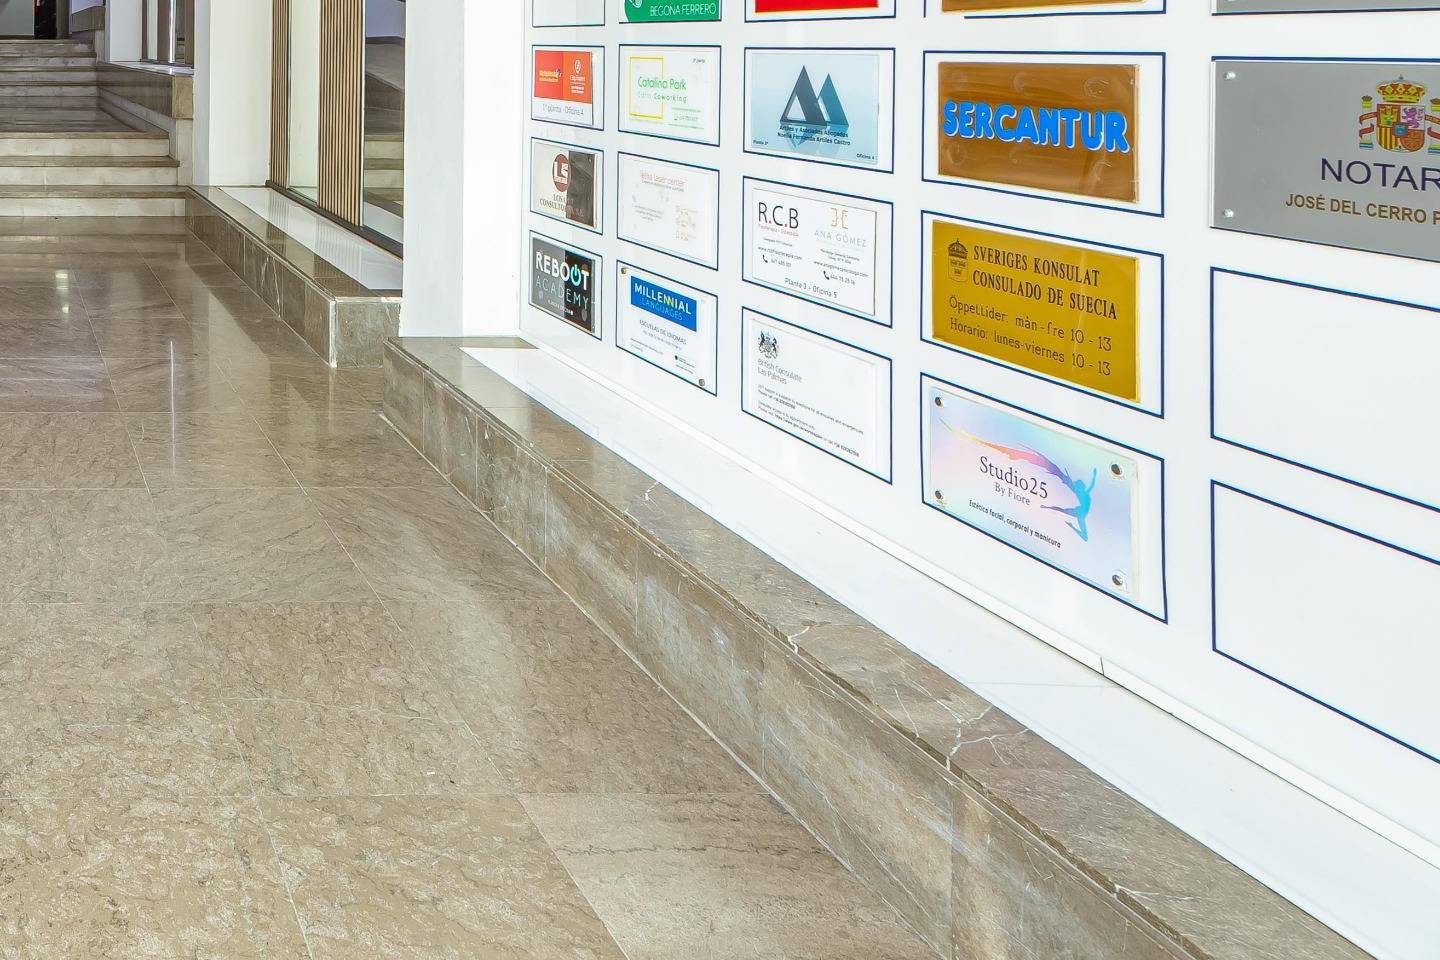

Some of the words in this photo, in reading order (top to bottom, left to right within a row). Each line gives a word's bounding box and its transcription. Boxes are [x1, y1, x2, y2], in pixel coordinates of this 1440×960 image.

[681, 2, 717, 15] FERRERO
[637, 76, 668, 89] Catalina
[669, 78, 687, 90] Park
[943, 99, 1130, 154] SERCANTUR
[1321, 157, 1440, 192] NOTAR
[758, 201, 799, 229] R.C.B
[1285, 193, 1326, 211] JOSÉ
[1330, 198, 1362, 216] DEL
[1365, 203, 1427, 224] CERRO
[814, 230, 831, 240] ANA
[973, 245, 1029, 271] SVERIGES
[1033, 257, 1100, 288] KONSULAT
[535, 275, 589, 310] ACADEMY
[634, 282, 692, 315] MILLENNIAL
[784, 277, 803, 290] Planta
[812, 285, 832, 298] Oficina
[833, 291, 838, 299] 5
[972, 269, 1042, 302] CONSULADO
[1047, 287, 1064, 307] DE
[1069, 291, 1118, 320] SUECIA
[641, 298, 683, 321] LANGUAGES
[993, 330, 1065, 363] lunes-viernes
[1071, 352, 1085, 369] 10
[1097, 360, 1111, 376] 13
[1070, 327, 1085, 344] 10
[1098, 335, 1112, 352] 13
[979, 455, 1049, 500] Studio25
[994, 481, 1006, 497] By
[1007, 487, 1031, 507] Fiore
[989, 508, 1006, 524] facial,
[1006, 518, 1030, 534] corporal
[1034, 530, 1061, 548] manicura
